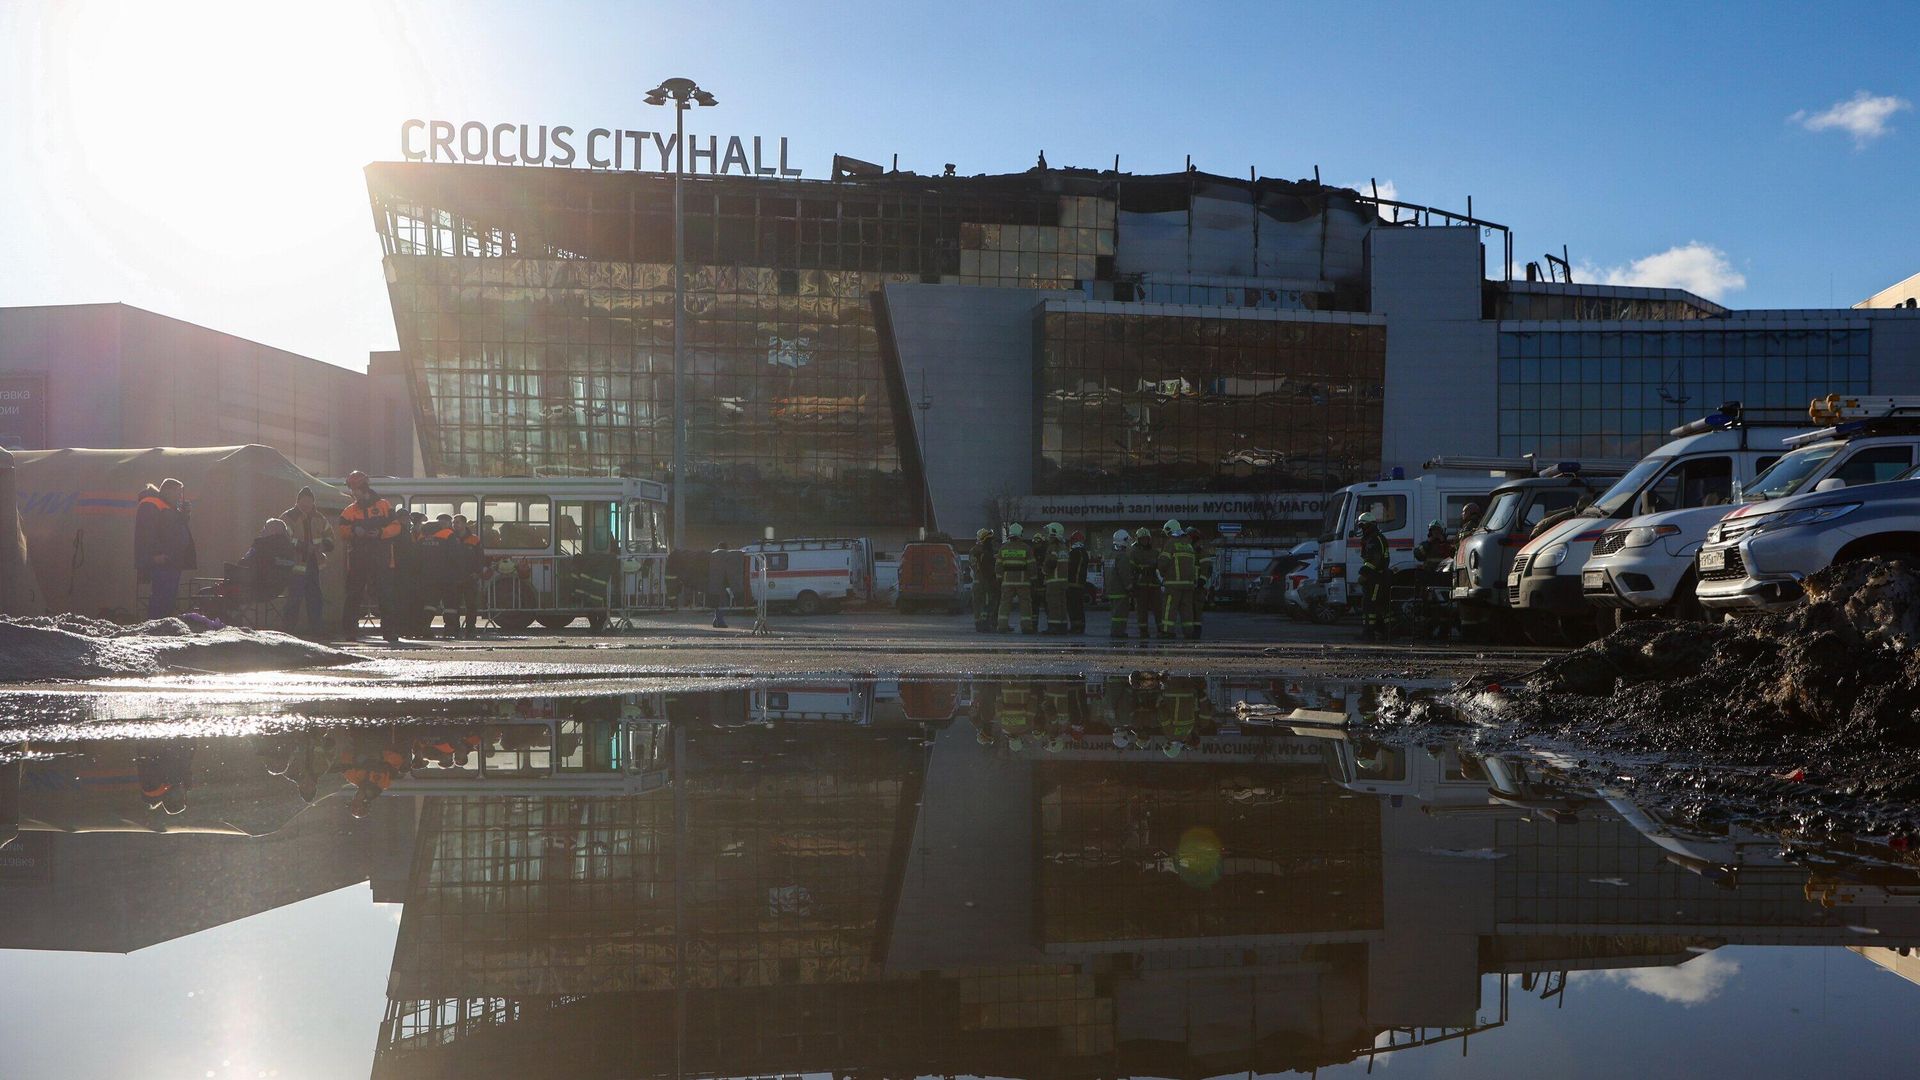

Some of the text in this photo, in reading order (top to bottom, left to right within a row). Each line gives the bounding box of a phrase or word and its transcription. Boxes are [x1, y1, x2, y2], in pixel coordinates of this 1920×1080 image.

[401, 118, 802, 176] CROCUS CITY HALL
[1041, 502, 1125, 517] концертный
[1128, 504, 1152, 514] зал
[1155, 503, 1199, 514] имени
[1203, 501, 1274, 513] МУСЛИМА
